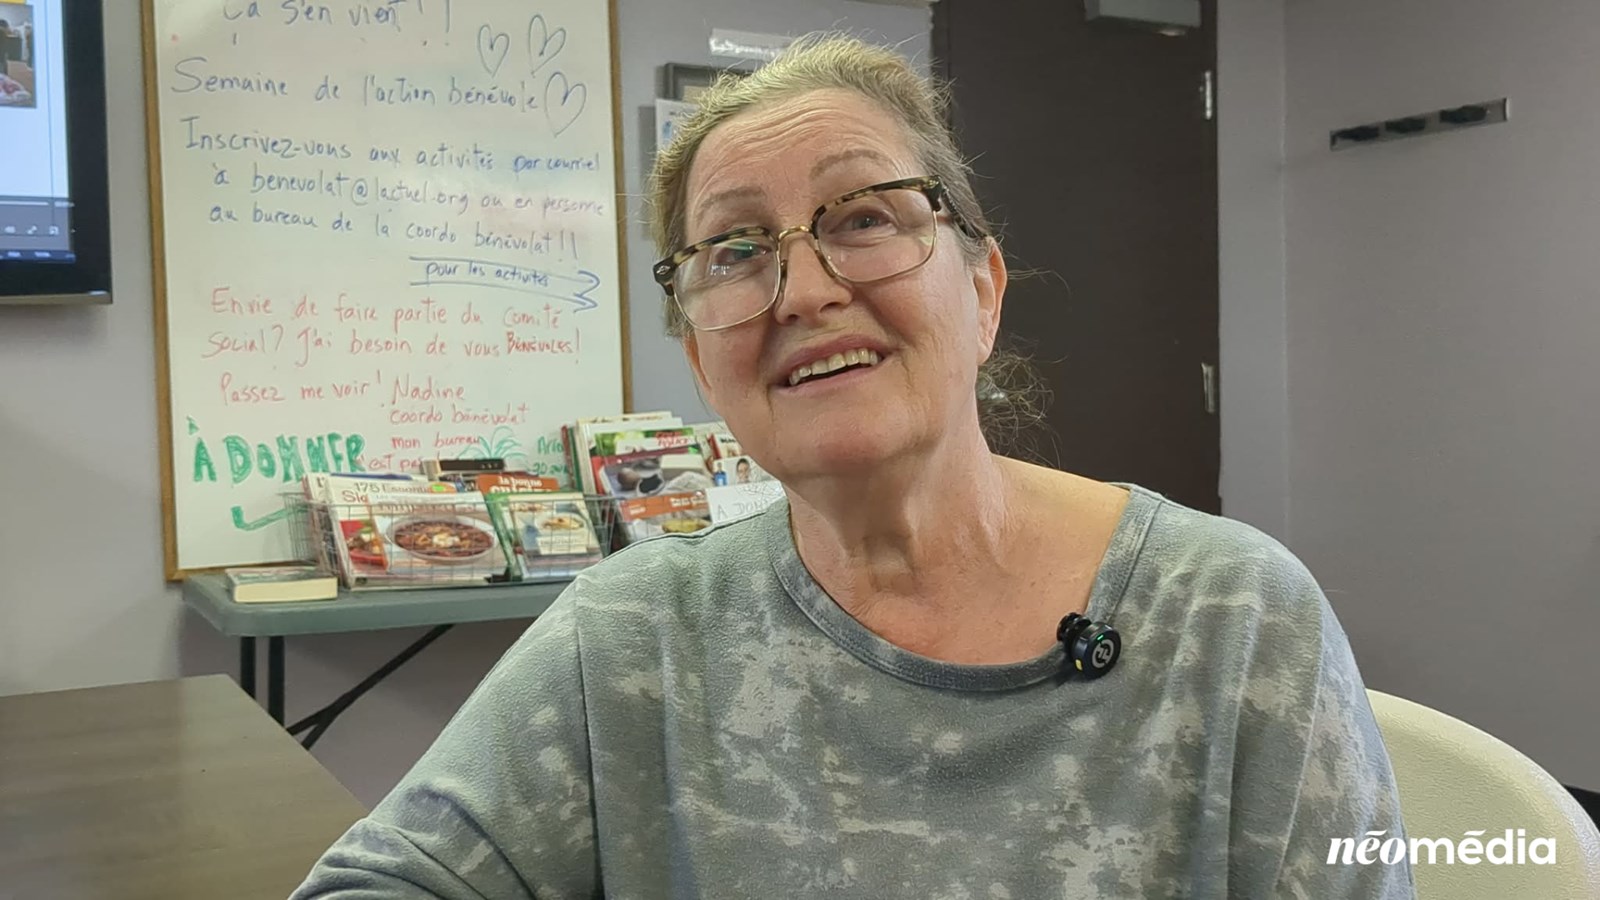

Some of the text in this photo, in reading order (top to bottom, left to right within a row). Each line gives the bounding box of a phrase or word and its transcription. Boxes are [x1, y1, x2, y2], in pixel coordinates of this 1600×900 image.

[171, 56, 539, 113] Semaine de l'action bénévole
[180, 115, 601, 182] Inscrivez-vous aux activités par courriel
[211, 161, 605, 220] à benevolat@lactuel.org ou en personne
[209, 205, 239, 224] au
[251, 200, 319, 229] bureau
[331, 210, 354, 232] de
[375, 213, 391, 238] la
[405, 220, 458, 244] coordo
[425, 261, 460, 289] pour
[468, 260, 487, 278] les
[210, 286, 273, 316] Envie
[293, 293, 320, 320] de
[333, 292, 379, 323] faire
[393, 296, 448, 334] partie
[460, 301, 482, 326] du
[294, 326, 333, 368] J'ai
[350, 328, 412, 356] besoin
[425, 333, 447, 356] de
[463, 342, 500, 358] vous
[219, 371, 286, 407] Passez
[301, 386, 325, 401] me
[390, 373, 465, 407] Nadine
[389, 405, 444, 426] coordo
[222, 432, 367, 484] DONNER
[391, 431, 482, 450] mon bureau
